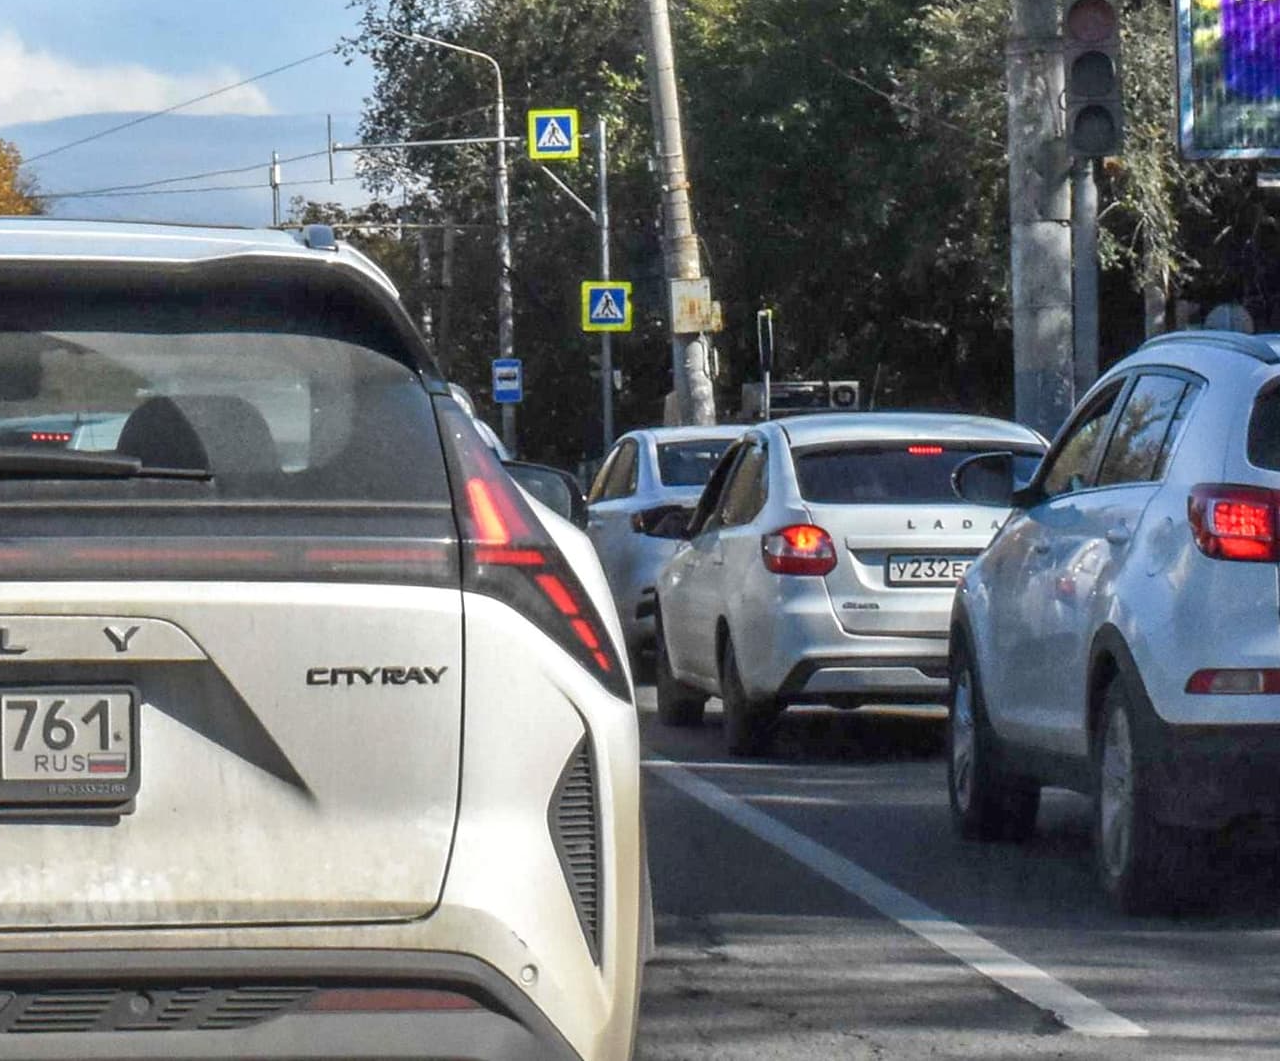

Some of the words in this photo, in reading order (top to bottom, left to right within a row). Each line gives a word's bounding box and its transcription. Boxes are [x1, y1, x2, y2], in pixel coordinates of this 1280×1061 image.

[907, 520, 1002, 530] LADA
[896, 557, 971, 579] У232Е
[306, 665, 448, 686] CITYRAY
[6, 699, 109, 751] 761
[34, 754, 85, 773] RUS
